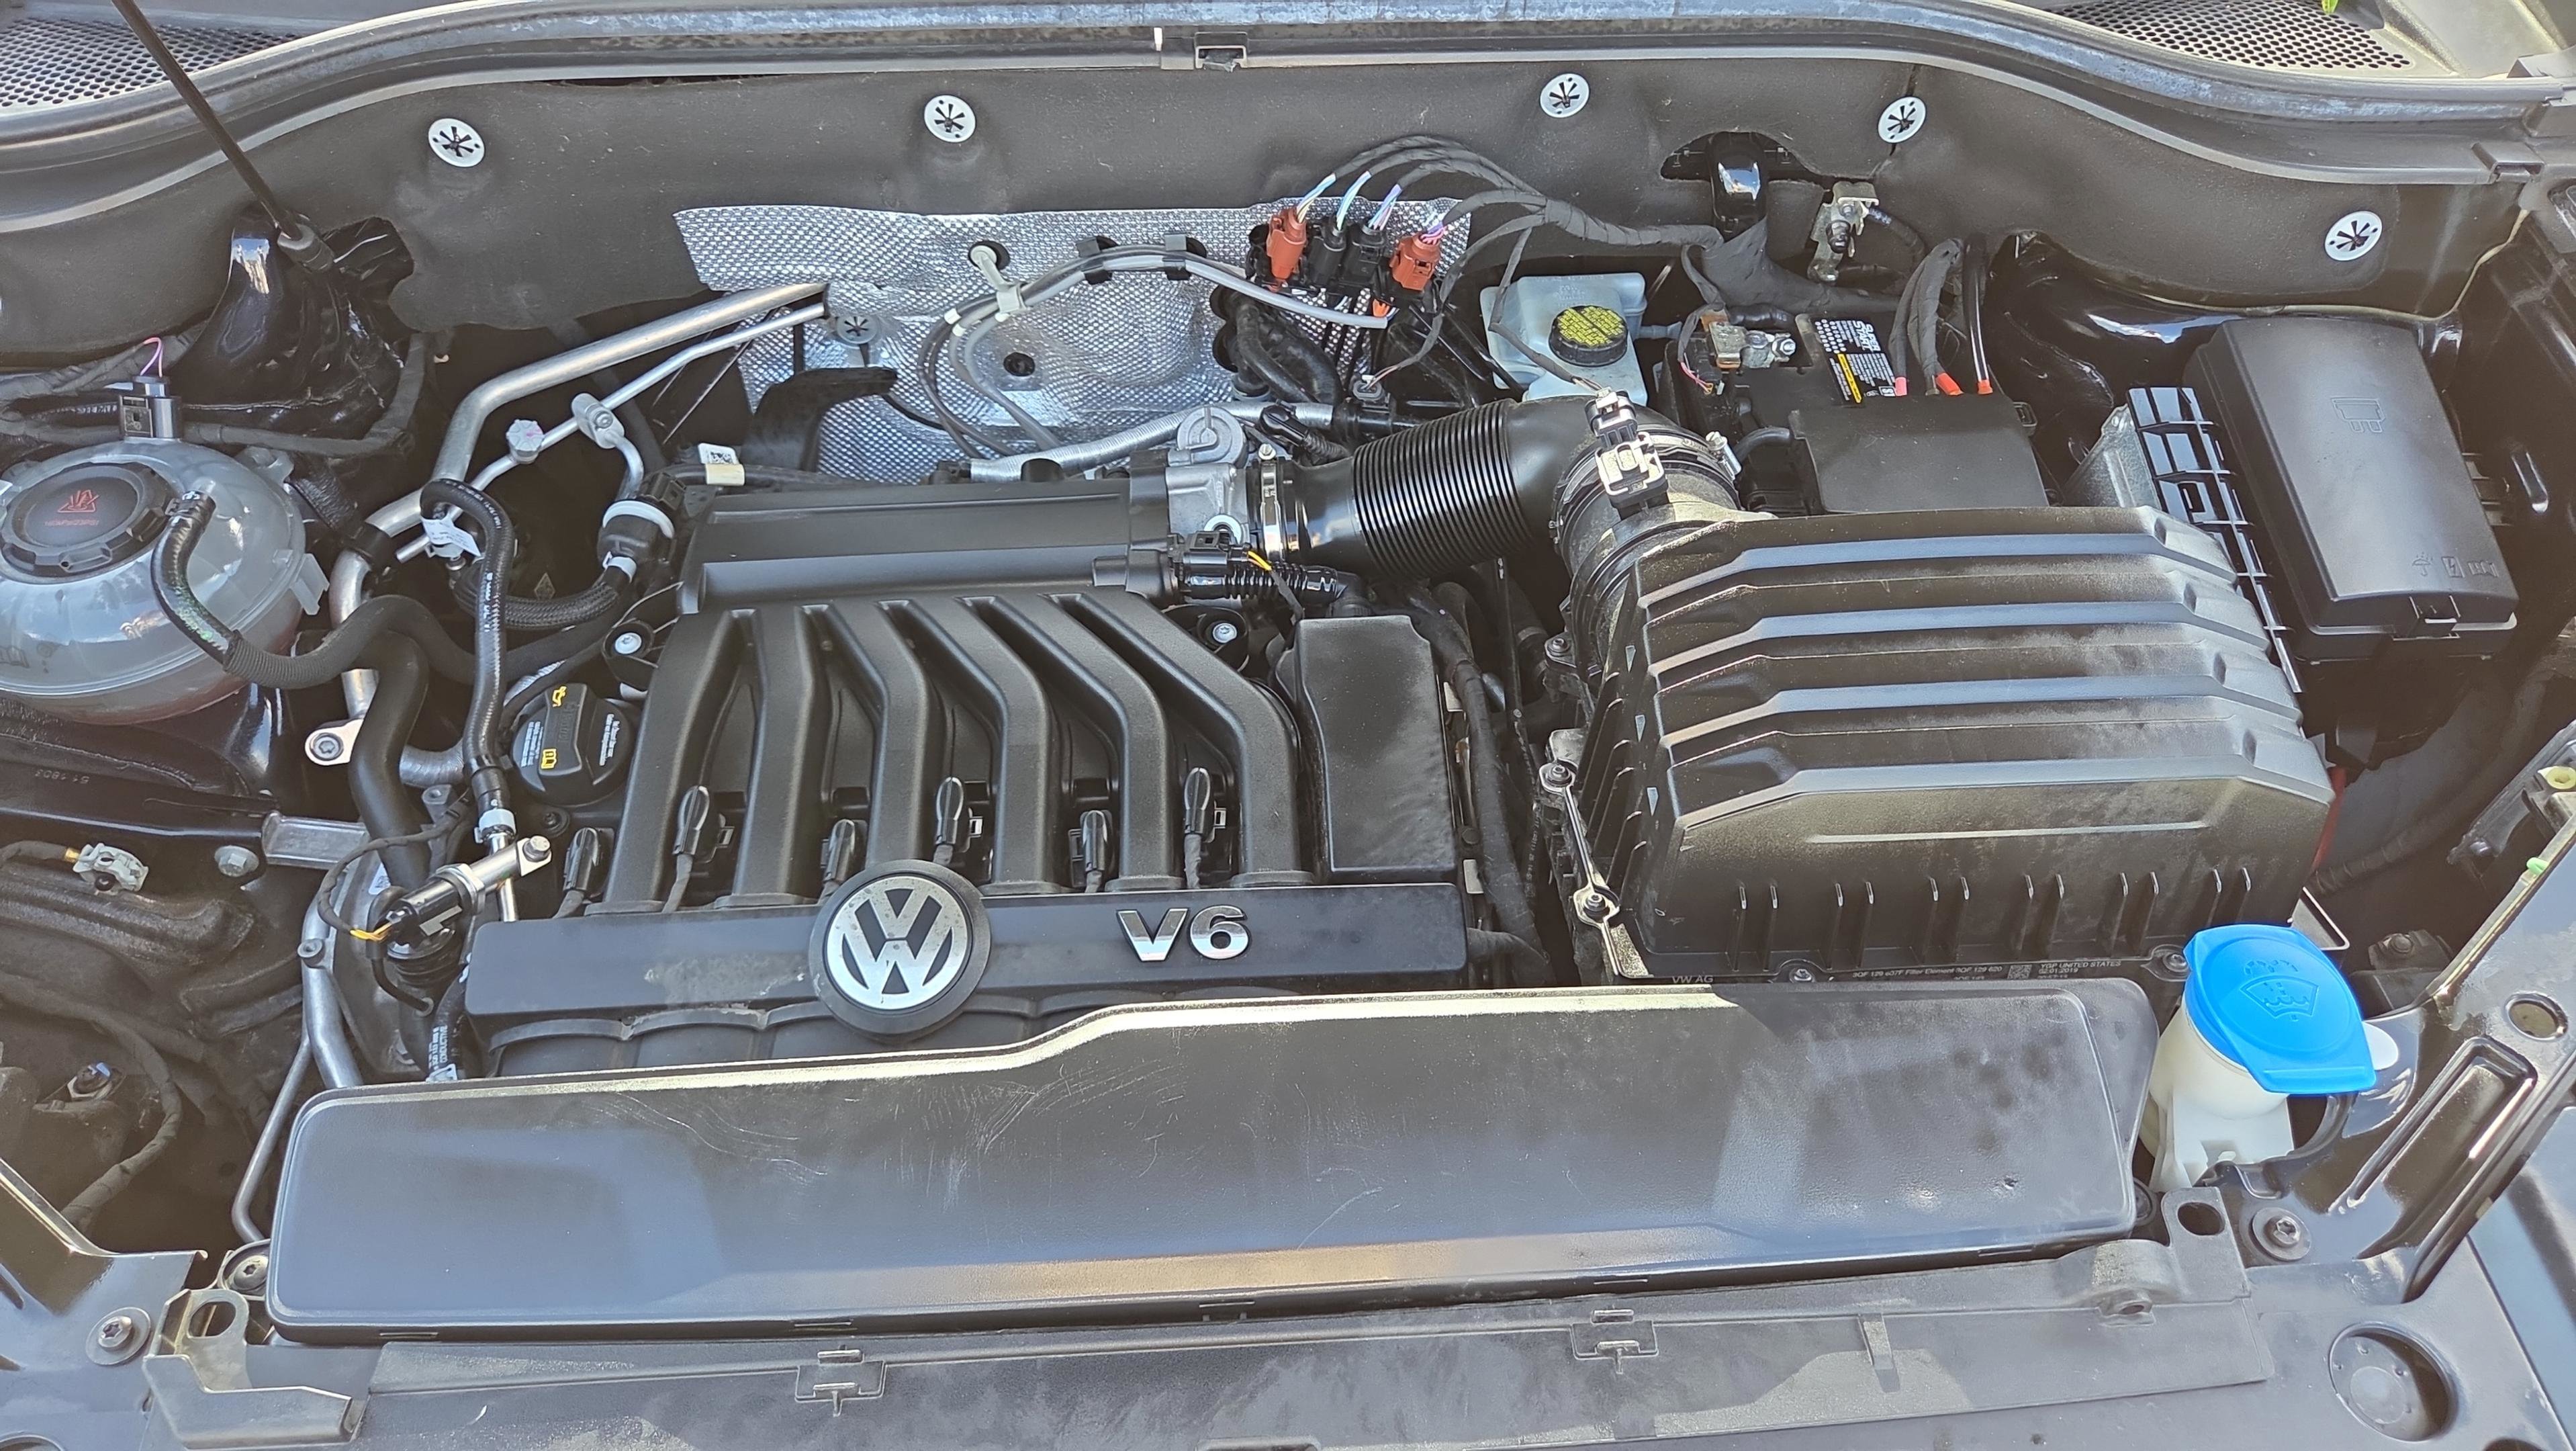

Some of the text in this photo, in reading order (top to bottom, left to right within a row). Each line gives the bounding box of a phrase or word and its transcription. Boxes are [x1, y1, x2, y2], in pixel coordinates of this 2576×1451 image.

[1852, 320, 1872, 352] START
[1866, 324, 1881, 351] SUPER
[1116, 904, 1250, 963] V6
[2090, 960, 2122, 968] STATES
[1671, 975, 1714, 984] VW AG
